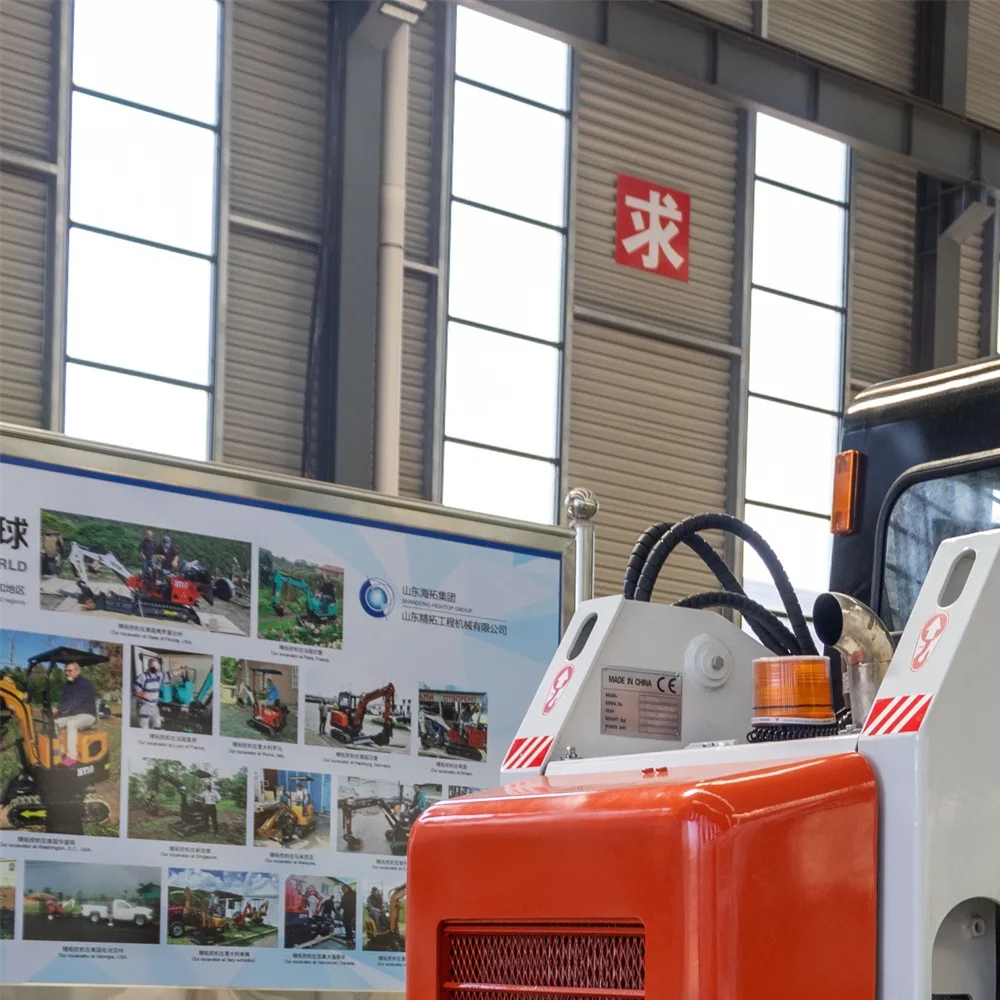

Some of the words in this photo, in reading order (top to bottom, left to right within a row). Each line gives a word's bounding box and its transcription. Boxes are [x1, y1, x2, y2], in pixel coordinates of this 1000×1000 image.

[621, 189, 684, 269] 求
[0, 516, 28, 549] 球
[402, 585, 456, 603] 山东海拓集团
[402, 599, 430, 607] SHANDONG
[401, 611, 507, 636] 山东精拓工程机械有限公司
[608, 675, 625, 684] MADE
[627, 677, 633, 685] IN
[635, 678, 652, 687] CHINA
[657, 676, 676, 694] CE
